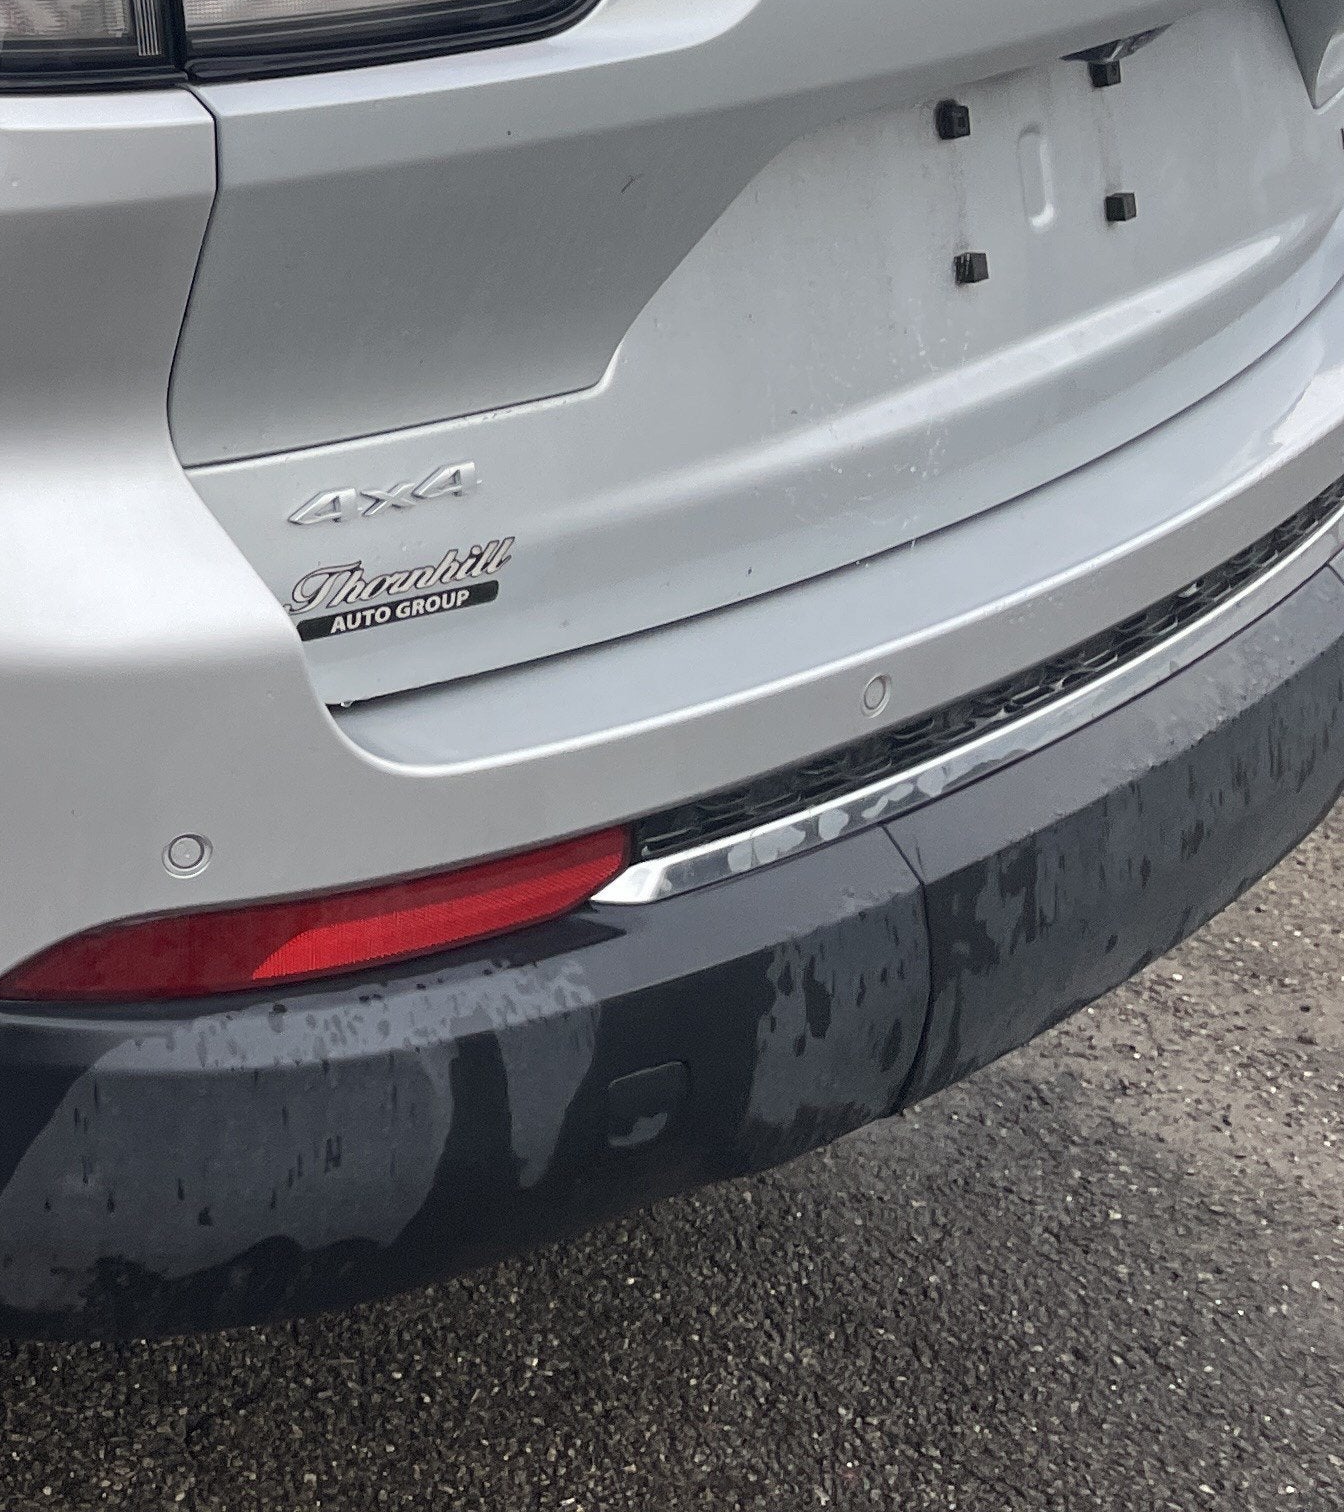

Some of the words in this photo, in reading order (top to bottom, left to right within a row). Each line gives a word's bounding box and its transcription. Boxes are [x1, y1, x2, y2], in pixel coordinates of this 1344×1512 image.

[283, 536, 516, 616] Thornhill
[330, 602, 392, 635] AUTO
[395, 589, 470, 620] GROUP
